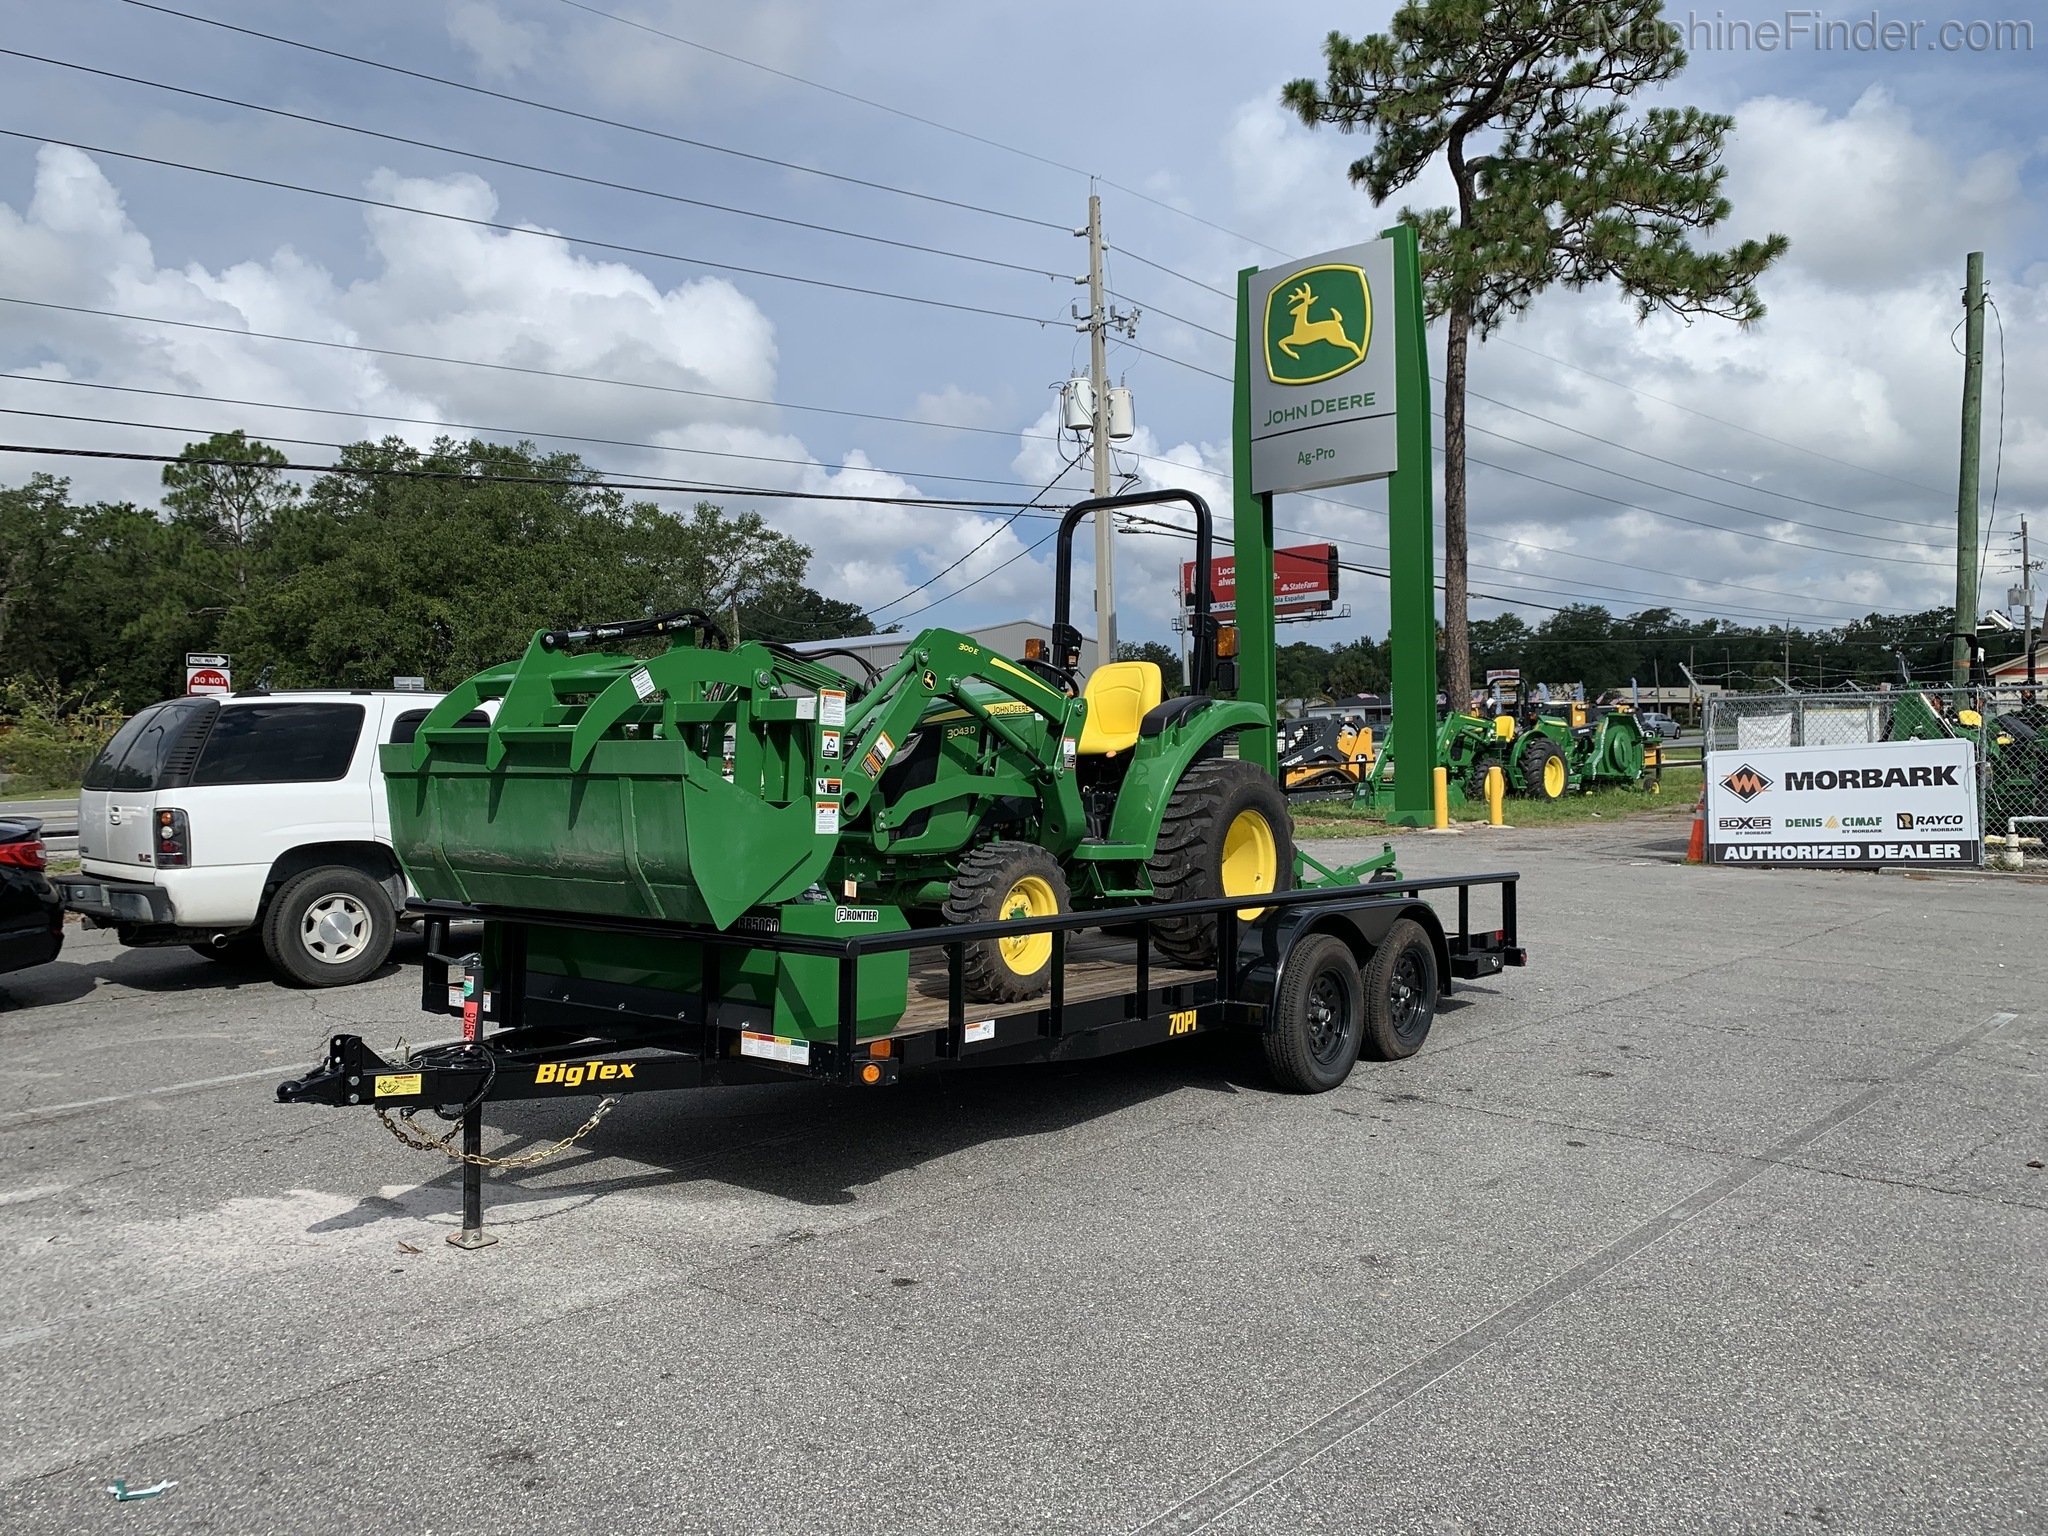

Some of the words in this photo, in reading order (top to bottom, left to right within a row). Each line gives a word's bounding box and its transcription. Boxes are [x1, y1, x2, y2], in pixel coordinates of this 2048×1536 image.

[1264, 404, 1308, 427] JOHN
[1311, 392, 1376, 416] DEERE
[1297, 448, 1336, 466] Ag-Pro
[1217, 566, 1236, 576] Loca
[1217, 577, 1236, 587] alwa
[194, 676, 206, 684] DO
[208, 677, 225, 685] NOT
[992, 705, 1010, 715] JOHN
[1009, 704, 1030, 714] DEERE
[1785, 765, 1960, 791] MORBARK
[1719, 816, 1772, 830] BOXER
[1785, 818, 1823, 828] DENIS
[1841, 817, 1882, 827] CIMAF
[1915, 815, 1963, 825] RAYCO
[1723, 844, 1861, 860] AUTHORIZED
[1868, 843, 1961, 859] DEALER
[836, 907, 878, 921] FRONTIER
[1168, 1009, 1197, 1036] 70PI
